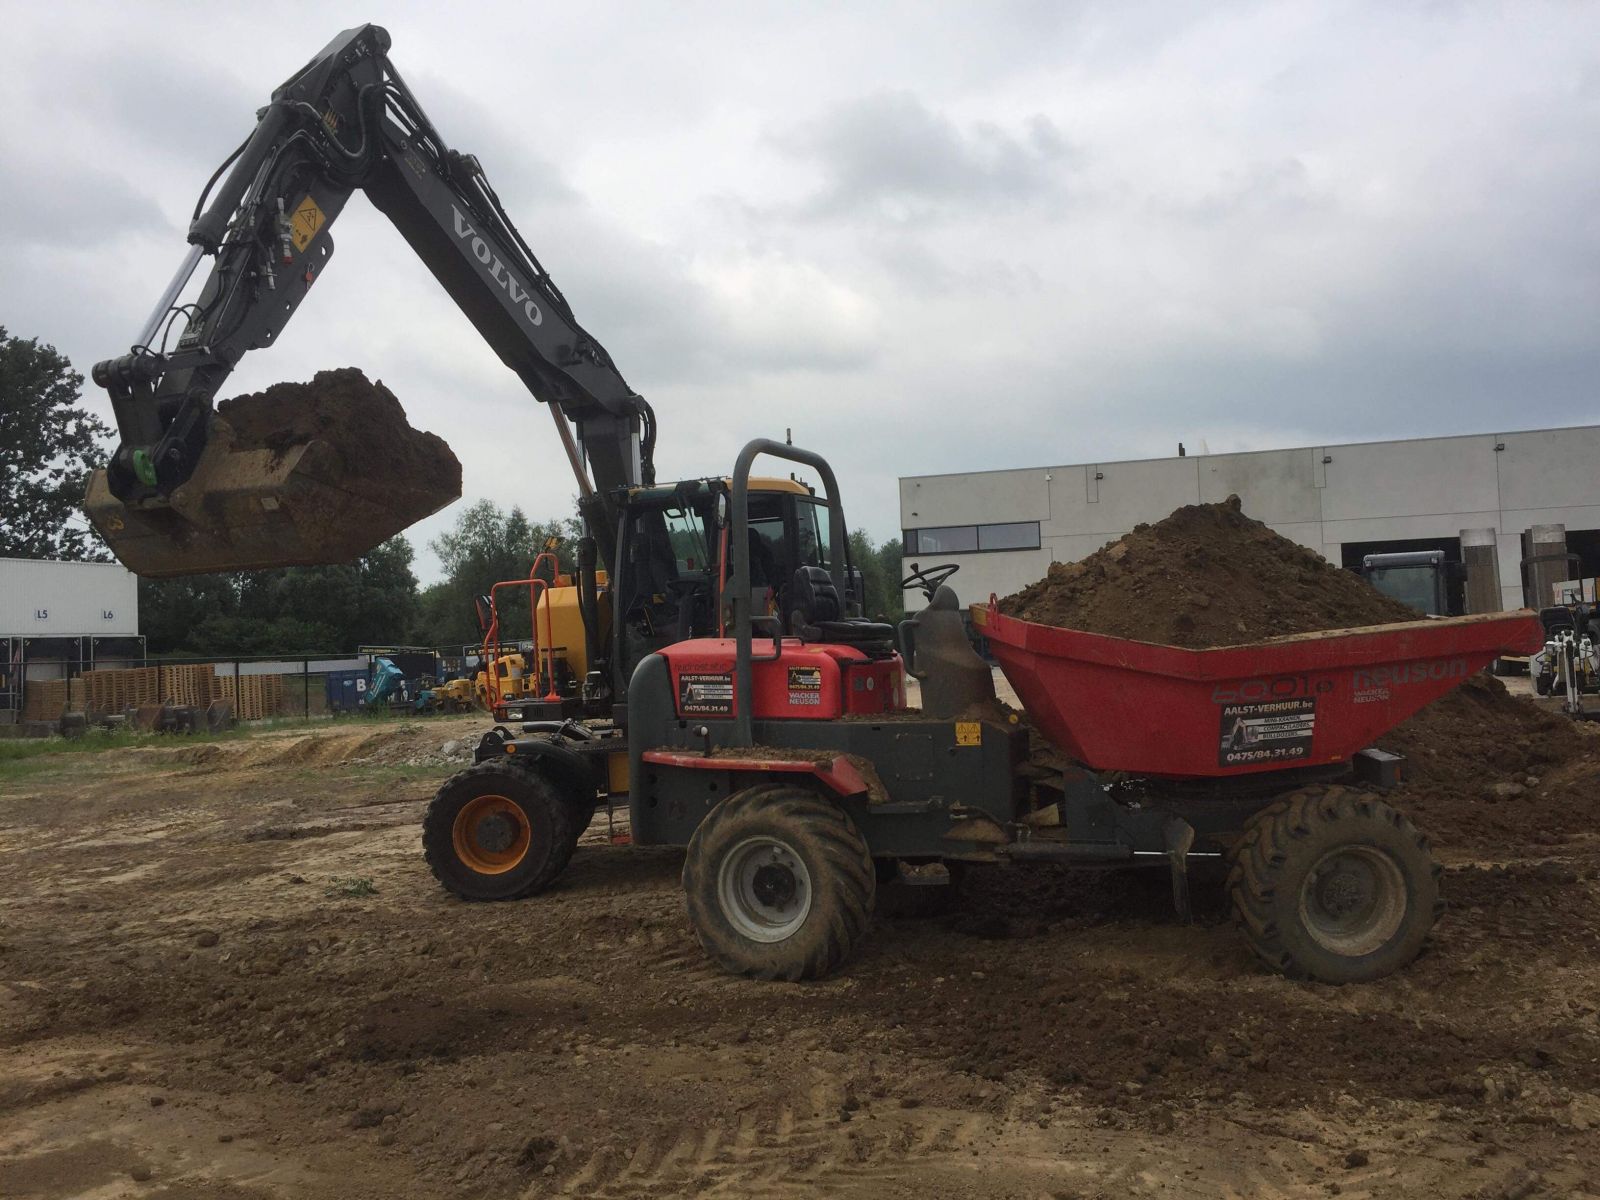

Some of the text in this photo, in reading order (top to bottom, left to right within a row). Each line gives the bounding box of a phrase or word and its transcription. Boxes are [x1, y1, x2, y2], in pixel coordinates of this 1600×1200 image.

[451, 204, 542, 326] VOLVO
[37, 610, 48, 619] L5
[103, 611, 114, 619] L6
[1353, 658, 1468, 688] neuson
[1224, 701, 1313, 716] AALST-VERHUUR.be
[1226, 747, 1304, 762] 0475/84.31.49
